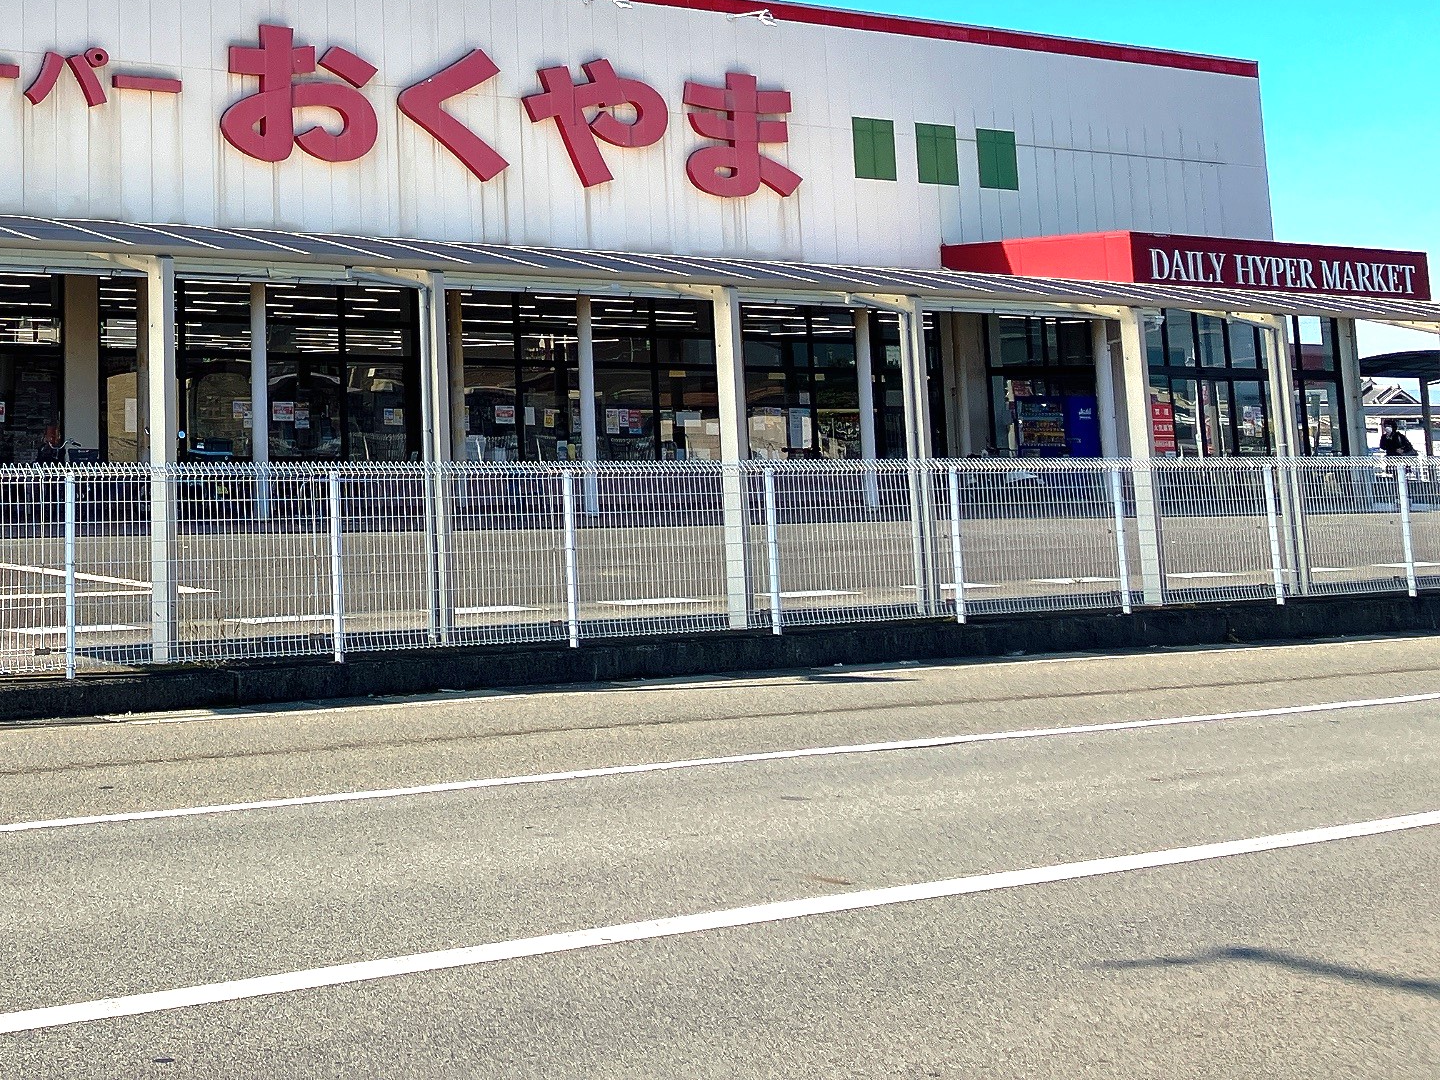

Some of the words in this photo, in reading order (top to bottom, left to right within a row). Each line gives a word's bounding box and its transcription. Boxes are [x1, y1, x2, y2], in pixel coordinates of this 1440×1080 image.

[219, 23, 803, 198] おくやま
[1148, 248, 1225, 283] DAILY
[1233, 254, 1317, 289] HYPER
[1320, 260, 1416, 295] MARKET
